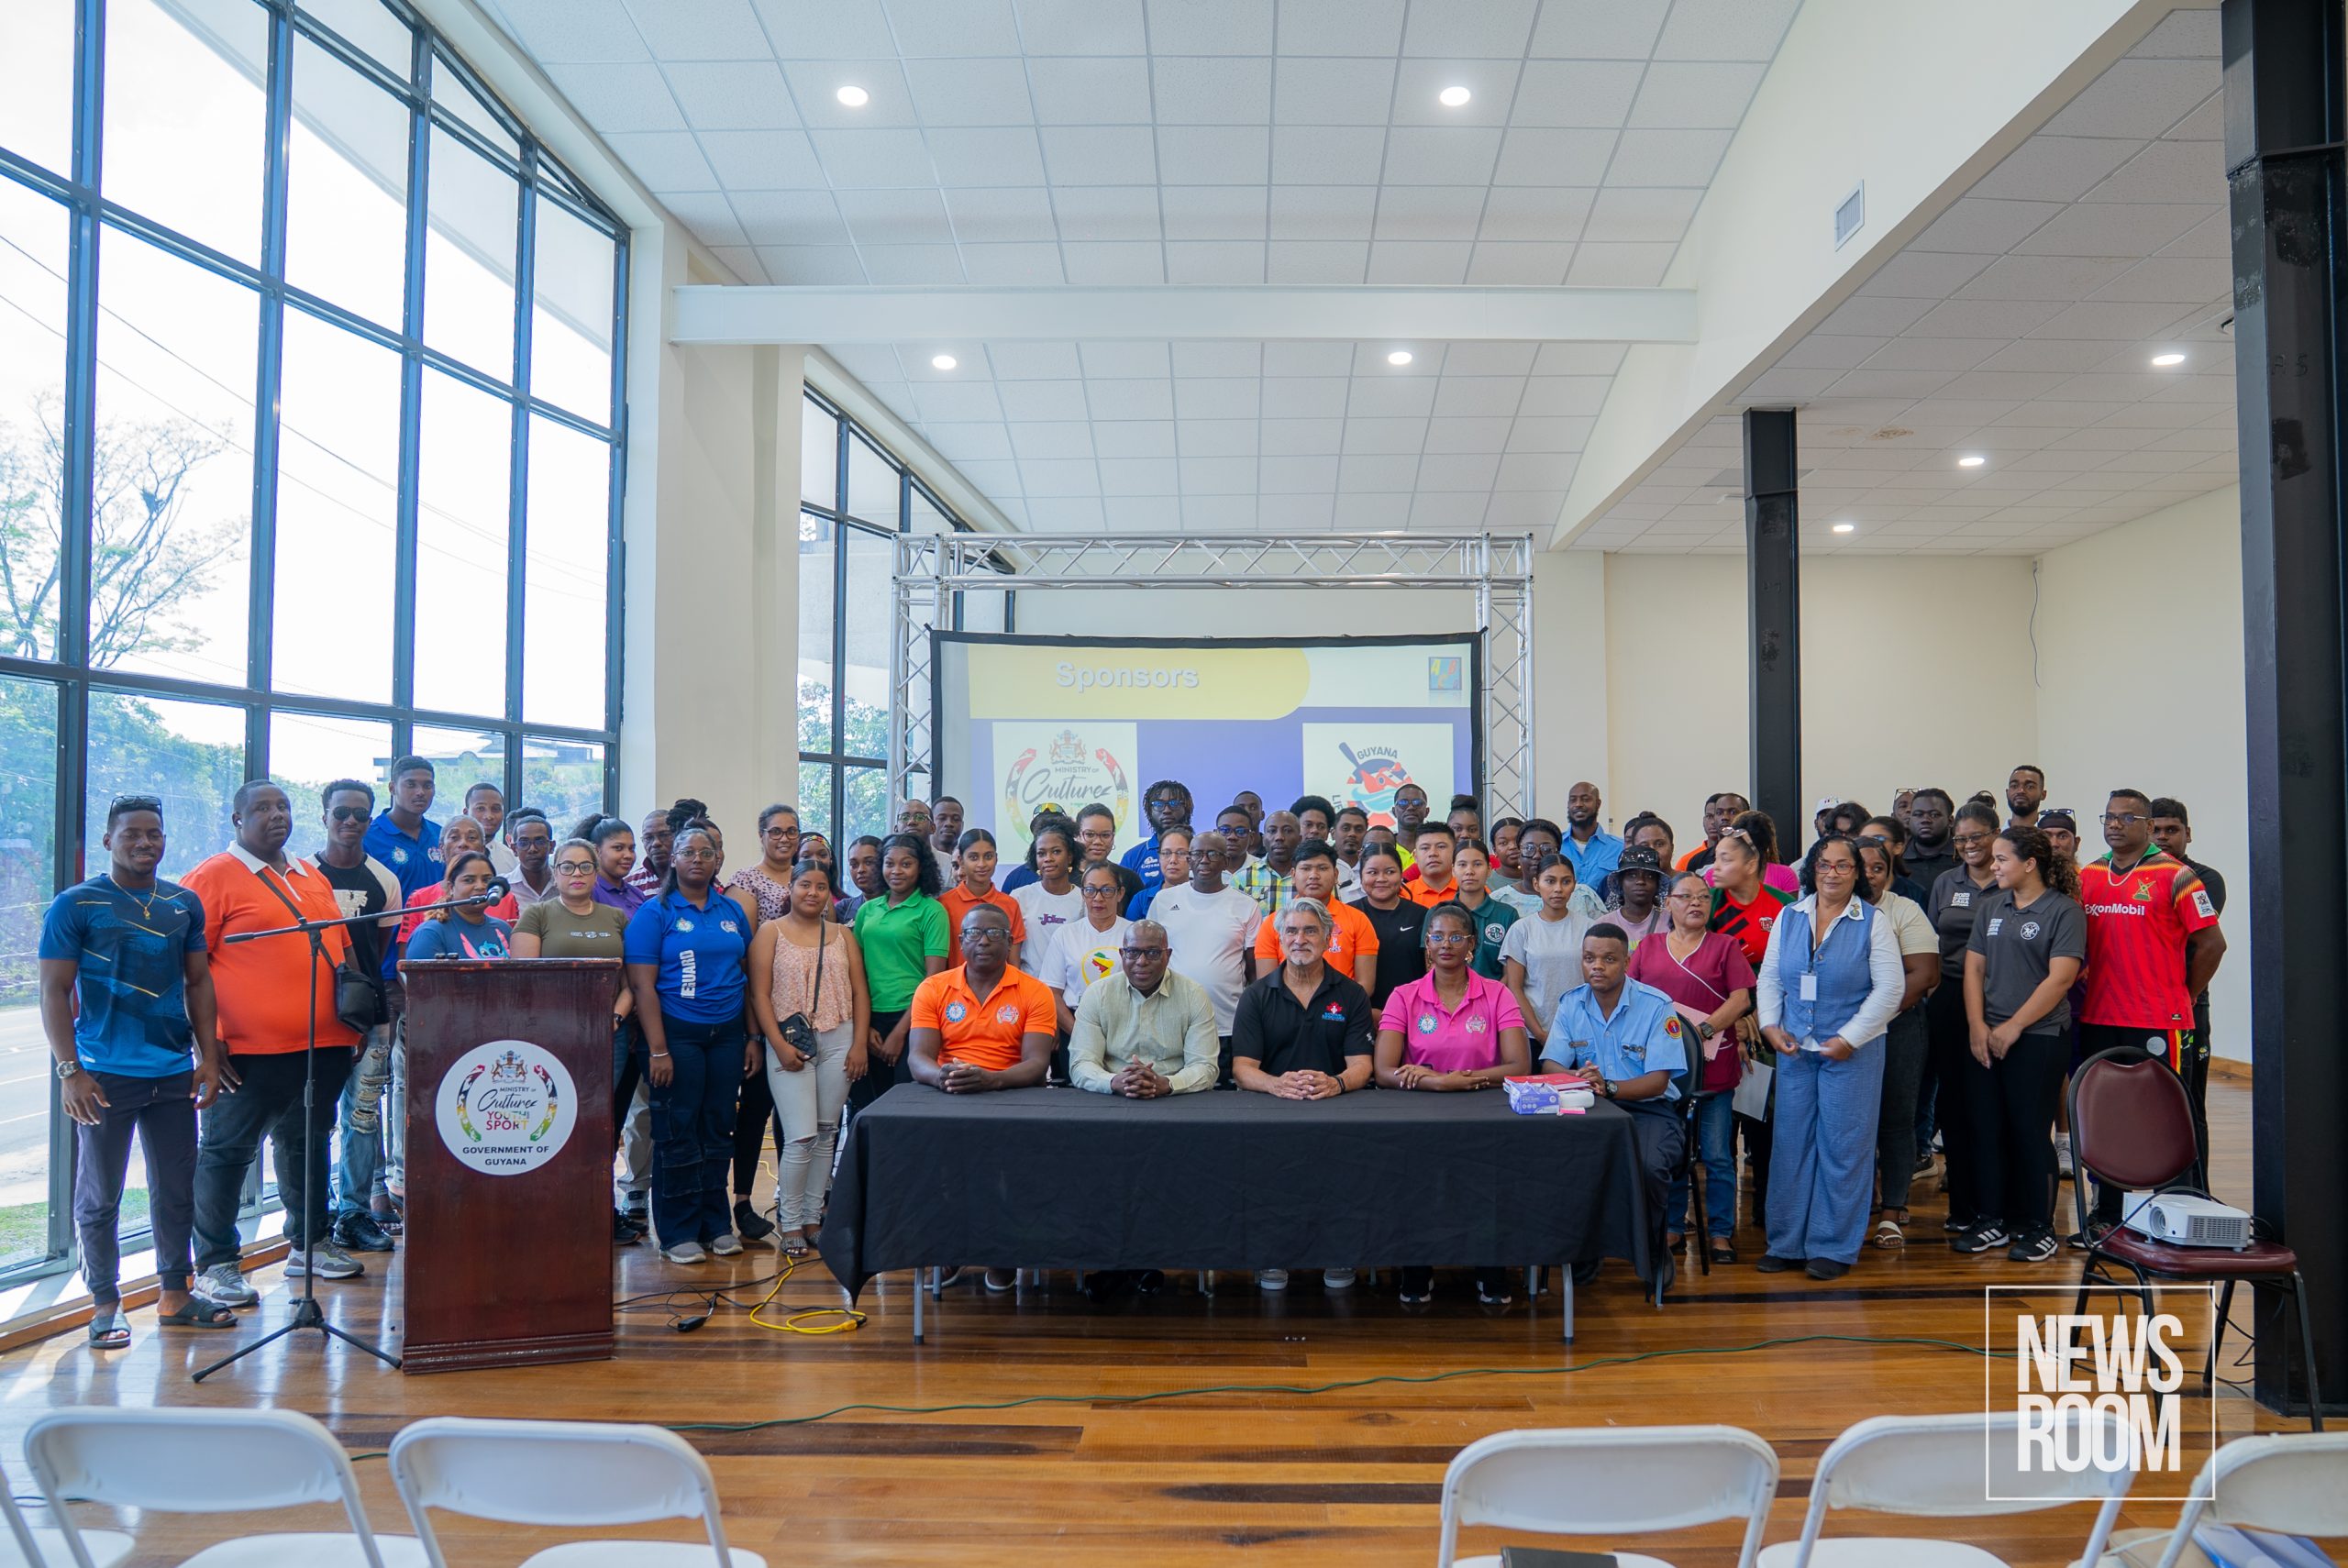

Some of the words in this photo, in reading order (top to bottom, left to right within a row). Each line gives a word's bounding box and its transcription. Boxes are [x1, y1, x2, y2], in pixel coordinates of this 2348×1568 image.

[1057, 660, 1200, 693] Sponsors
[1357, 746, 1399, 760] GUYANA
[1022, 768, 1113, 804] Culture
[2085, 903, 2145, 916] ExxonMobil
[477, 1088, 538, 1112] Culture
[485, 1120, 529, 1131] SPORT
[462, 1146, 533, 1154] GOVERNMENT
[537, 1145, 549, 1154] OF
